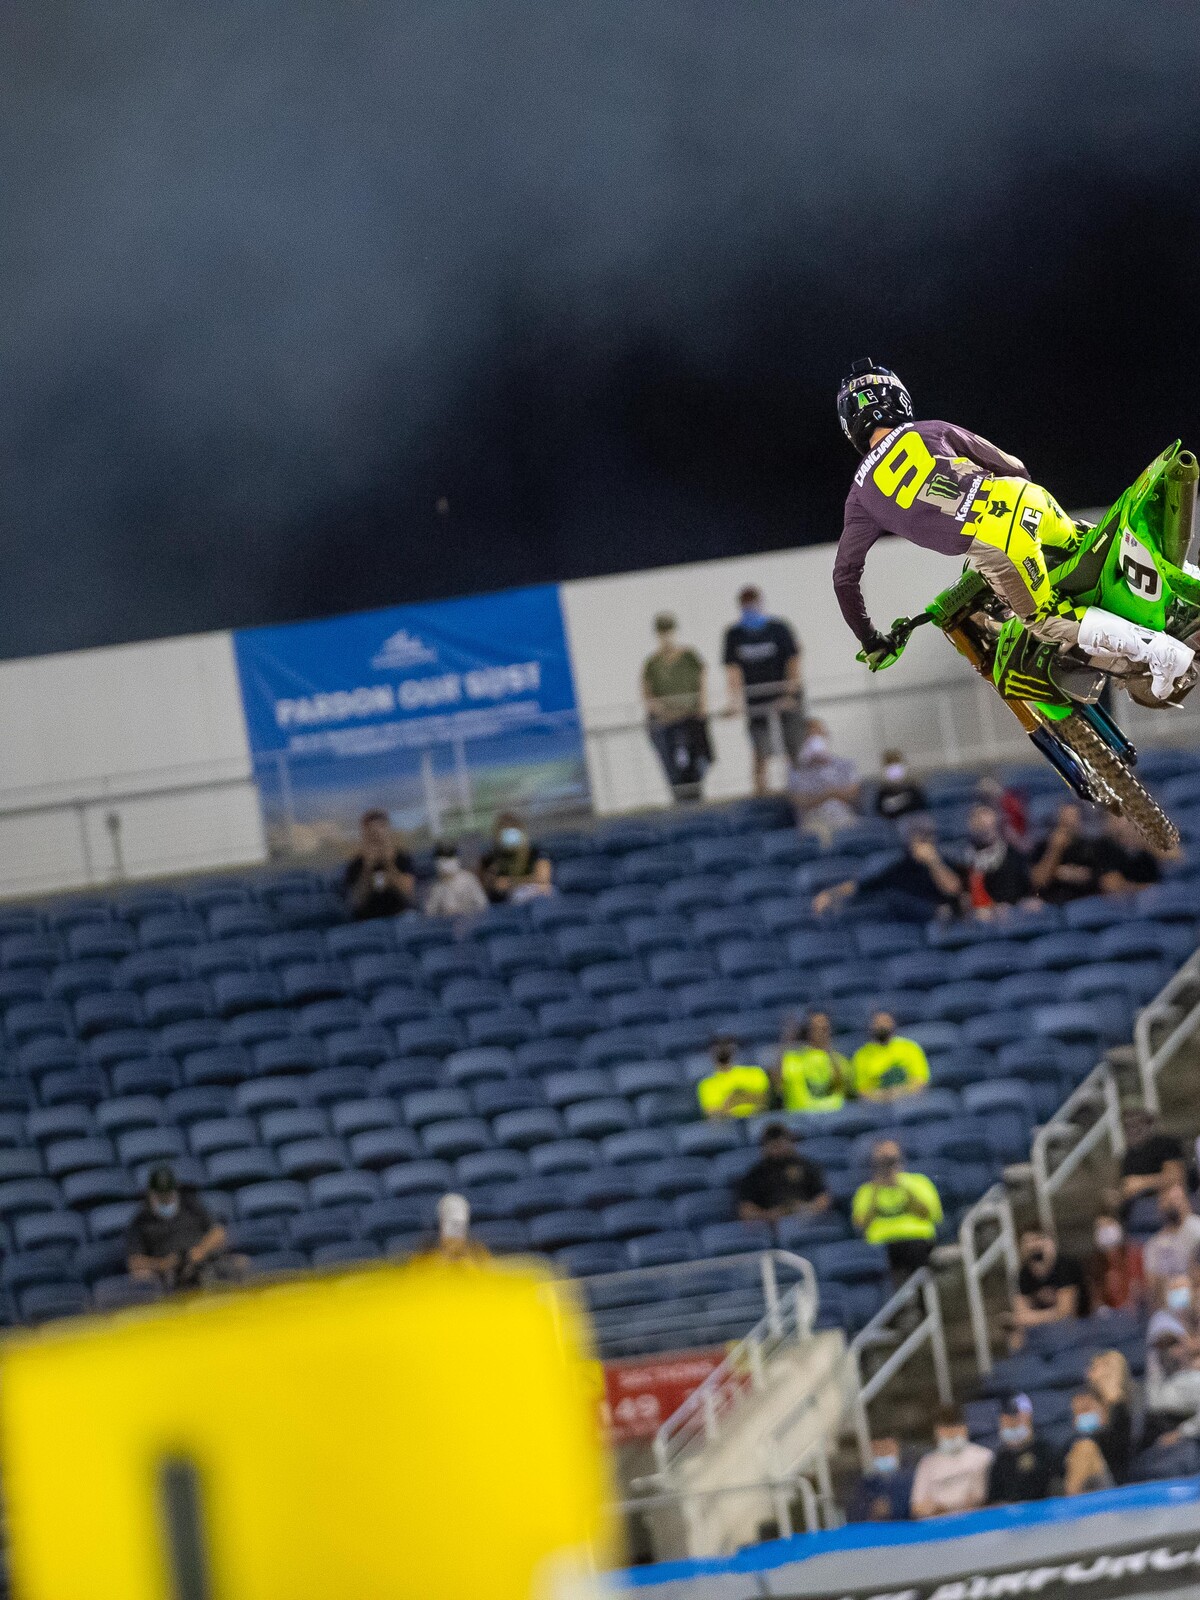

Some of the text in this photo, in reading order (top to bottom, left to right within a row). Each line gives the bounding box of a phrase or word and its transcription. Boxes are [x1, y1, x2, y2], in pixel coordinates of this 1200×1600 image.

[872, 430, 937, 510] 9
[1019, 506, 1043, 542] AC
[1123, 554, 1158, 595] 9
